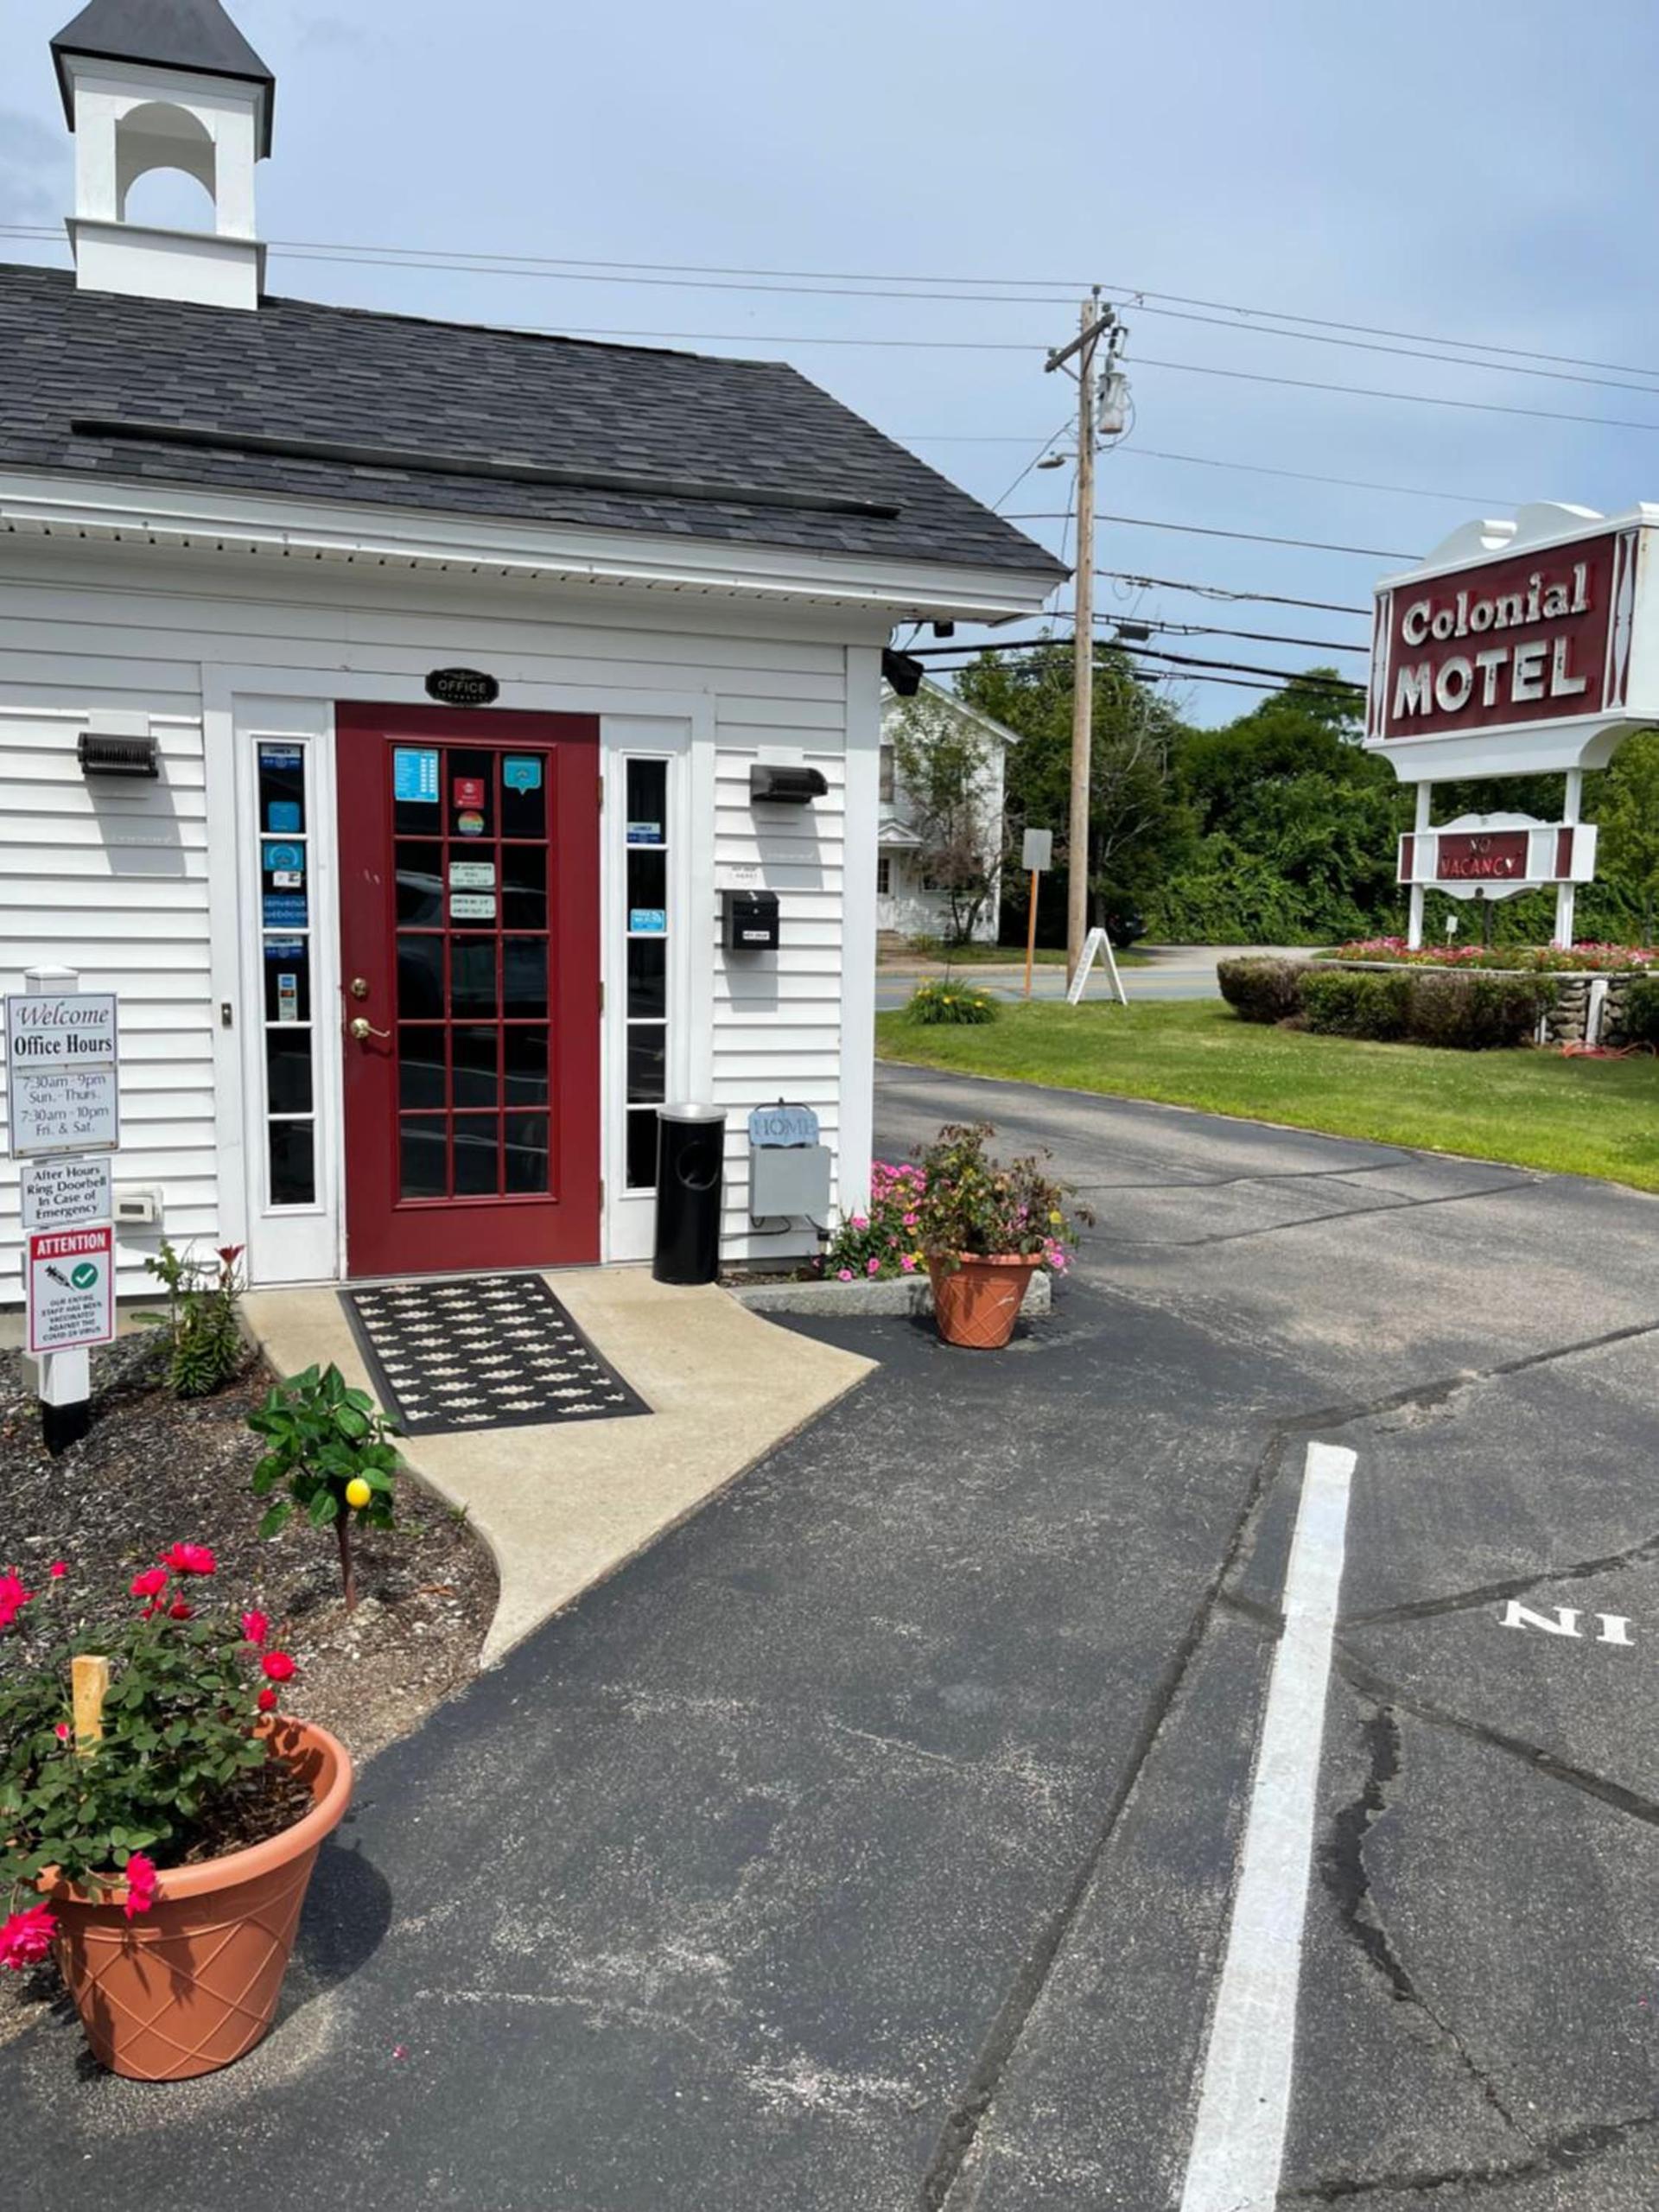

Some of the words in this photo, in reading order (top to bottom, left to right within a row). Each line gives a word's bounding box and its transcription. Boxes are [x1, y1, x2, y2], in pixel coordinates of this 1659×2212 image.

[1402, 563, 1590, 645] Colonial
[437, 679, 486, 694] OFFICE
[1392, 636, 1586, 720] MOTEL
[1470, 838, 1491, 854] NO
[1440, 856, 1516, 876] VACANCY
[16, 1001, 109, 1026] Welcome
[14, 1035, 61, 1056] Office
[67, 1034, 112, 1054] Hours
[22, 1075, 68, 1090] 7:30am
[21, 1109, 67, 1122] 7:30am
[77, 1107, 109, 1121] 10pm
[58, 1123, 68, 1134] &
[754, 1117, 817, 1135] HOME
[35, 1170, 63, 1181] After
[67, 1166, 100, 1177] Hours
[27, 1184, 54, 1196] Ring
[57, 1176, 106, 1192] Doorbell
[38, 1197, 50, 1206] In
[54, 1193, 81, 1205] Case
[84, 1189, 96, 1200] of
[35, 1205, 97, 1219] Emergency
[37, 1232, 105, 1255] ATTENTION
